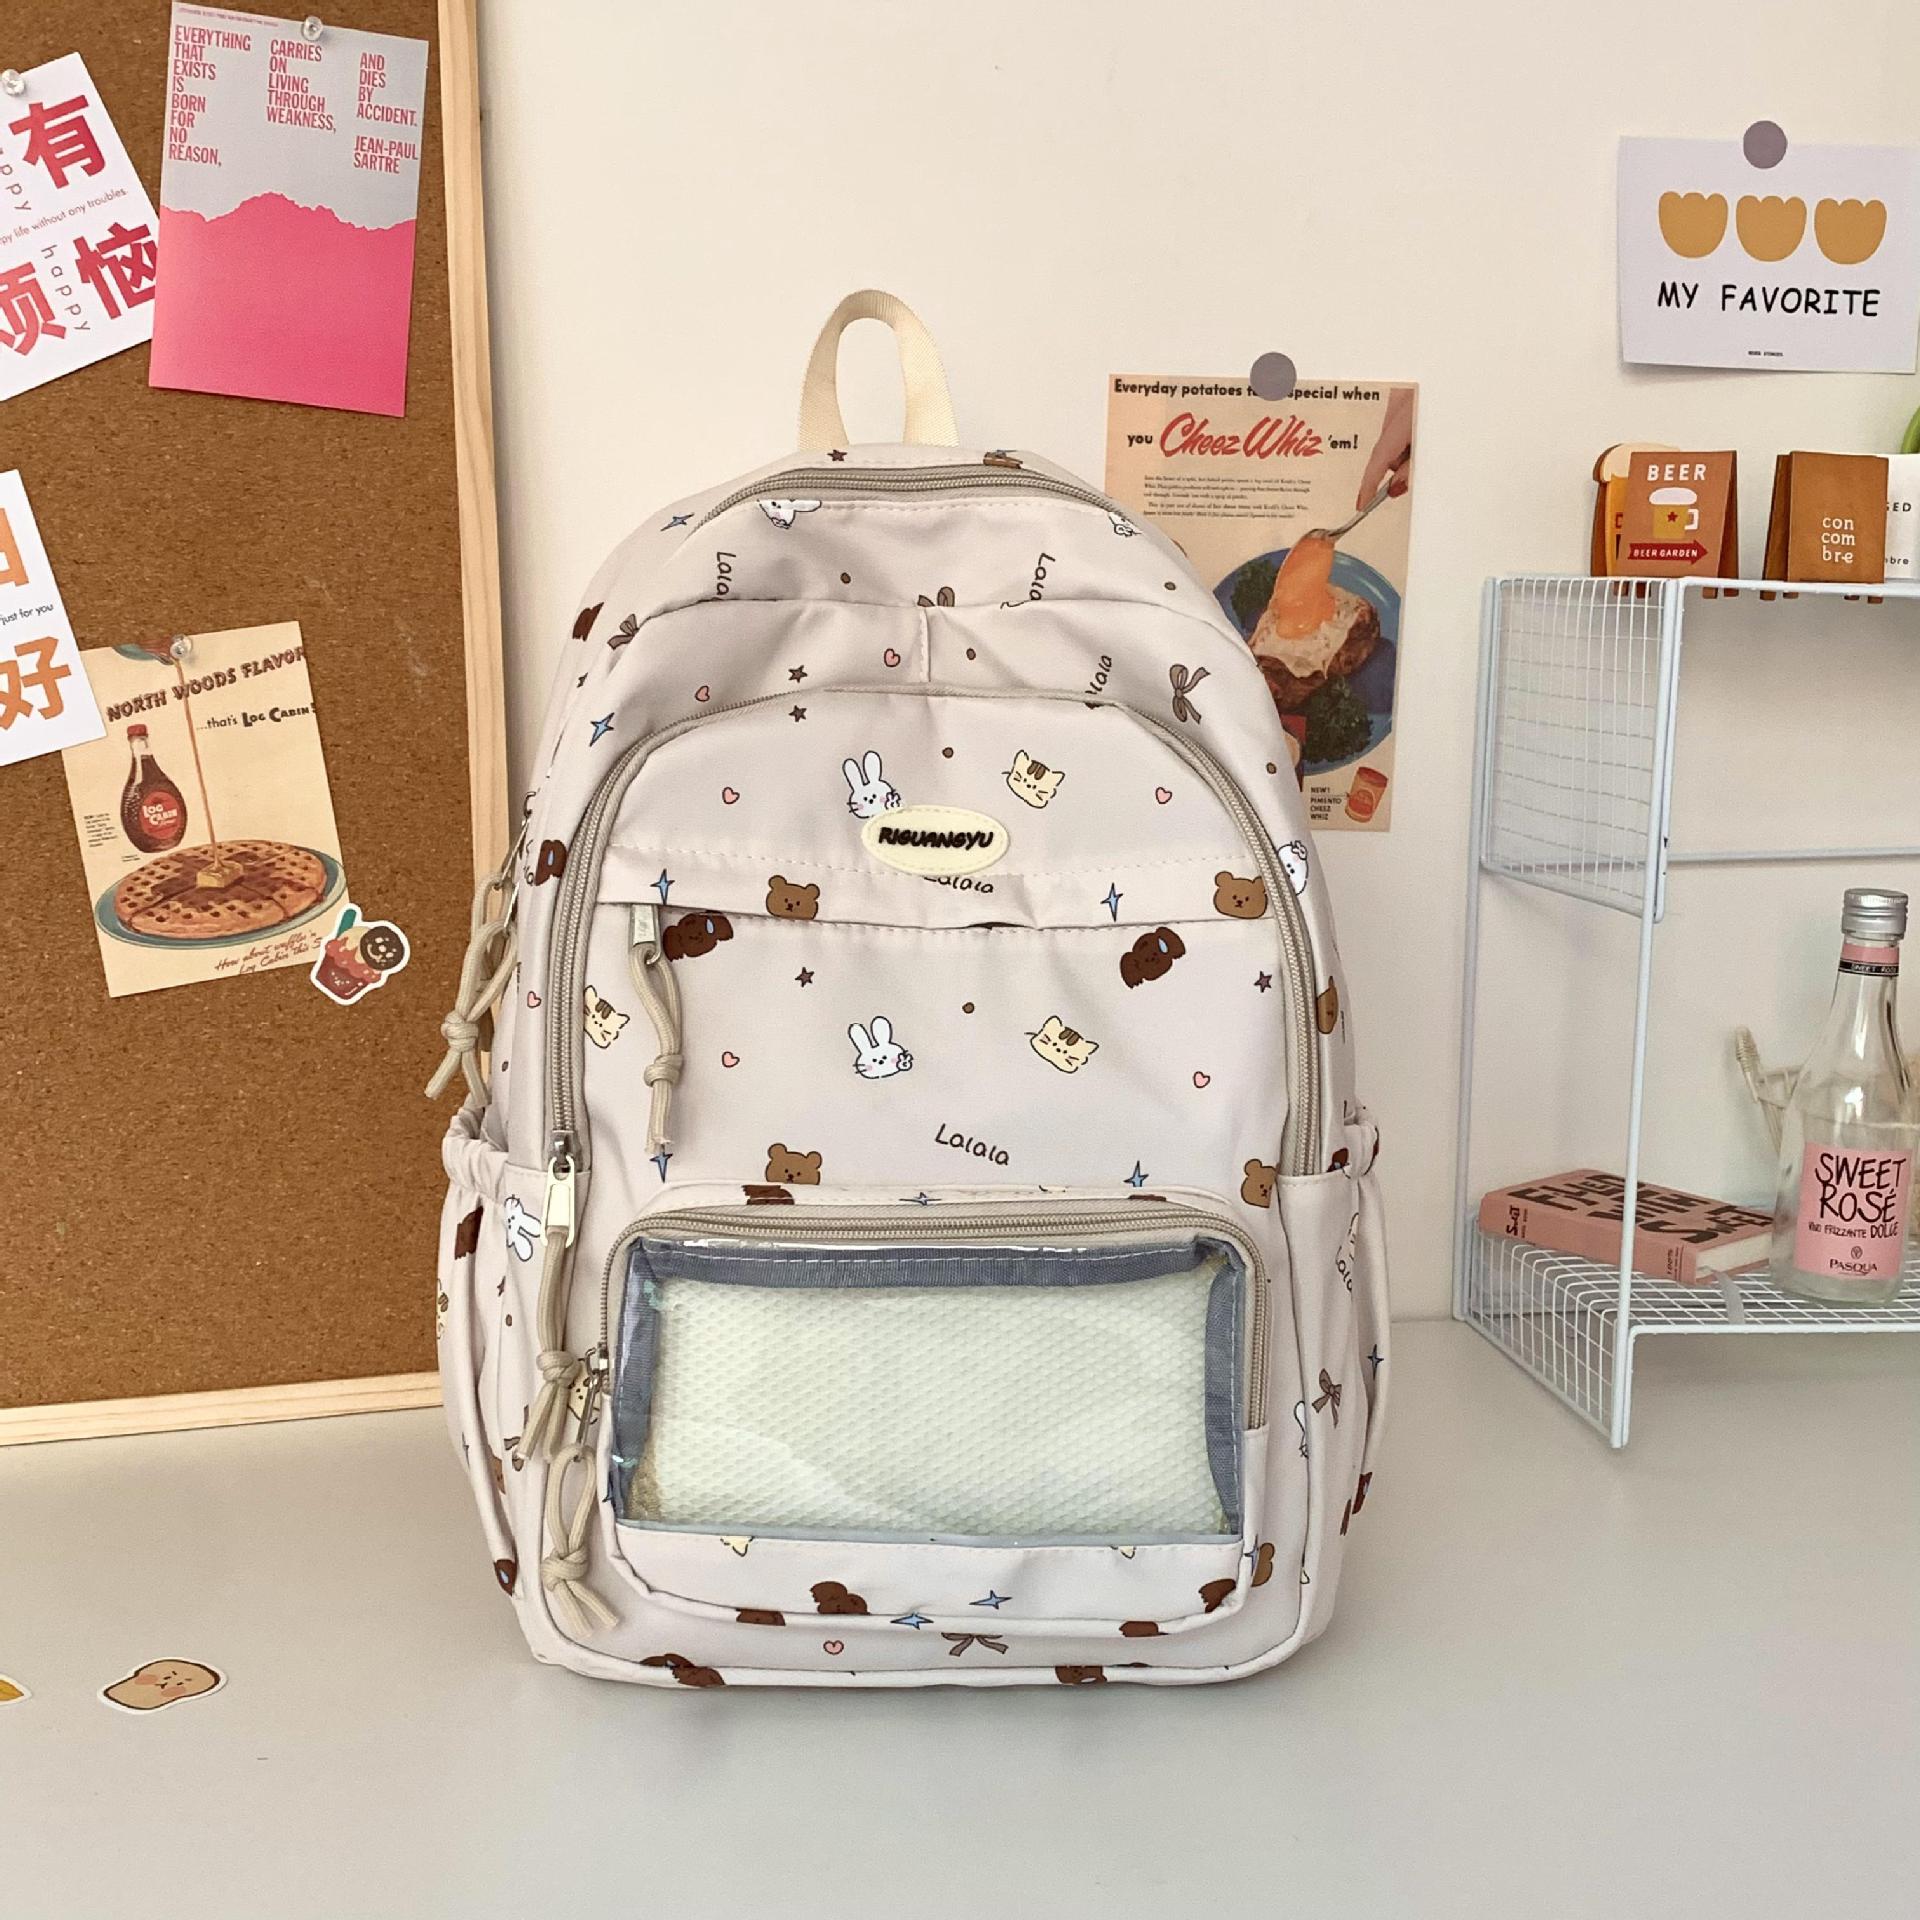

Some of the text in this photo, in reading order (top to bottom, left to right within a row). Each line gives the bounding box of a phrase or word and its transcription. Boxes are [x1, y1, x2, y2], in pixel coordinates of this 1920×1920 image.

[174, 25, 251, 51] EVERYTHING
[174, 42, 206, 61] THAT
[270, 39, 322, 62] CARRIES
[360, 52, 385, 70] AND
[173, 59, 216, 80] EXISTS
[269, 56, 288, 73] ON
[172, 76, 185, 93] IS
[268, 73, 309, 93] LIVING
[359, 70, 386, 88] DIES
[171, 93, 206, 112] BORN
[267, 90, 325, 112] THROUGH
[358, 86, 374, 103] BY
[170, 110, 195, 128] FOR
[267, 106, 336, 133] WEAKNESS,
[356, 104, 418, 126] ACCIDENT.
[8, 94, 106, 189] 有
[169, 127, 187, 143] NO
[168, 143, 222, 166] REASON,
[354, 135, 418, 160] JEAN-PAUL
[353, 152, 400, 174] SARTRE
[14, 223, 30, 238] life
[32, 211, 66, 230] without
[68, 205, 86, 218] any
[41, 244, 91, 331] happy
[1657, 280, 1881, 317] MY FAVORITE
[1114, 377, 1178, 397] Everyday
[1181, 383, 1243, 398] potatoes
[1342, 385, 1380, 401] when
[1127, 434, 1153, 448] you
[1160, 412, 1241, 457] Cheez
[1243, 414, 1324, 459] Whiz
[1647, 463, 1707, 481] BEER
[1822, 517, 1854, 531] con
[1821, 532, 1856, 546] com
[1633, 548, 1698, 558] BEER GARDEN
[1822, 544, 1854, 564] bre
[0, 602, 54, 626] just for you
[0, 636, 72, 730] 好
[106, 688, 168, 722] NORTH
[172, 667, 237, 701] WOODS
[1310, 797, 1343, 805] PIMENTO
[934, 1123, 1010, 1166] Lalala
[1814, 1152, 1907, 1190] SWEET
[1819, 1183, 1897, 1222] ROSÉ
[1824, 1225, 1867, 1239] FRIZZANTE
[1829, 1258, 1878, 1275] PASQUA
